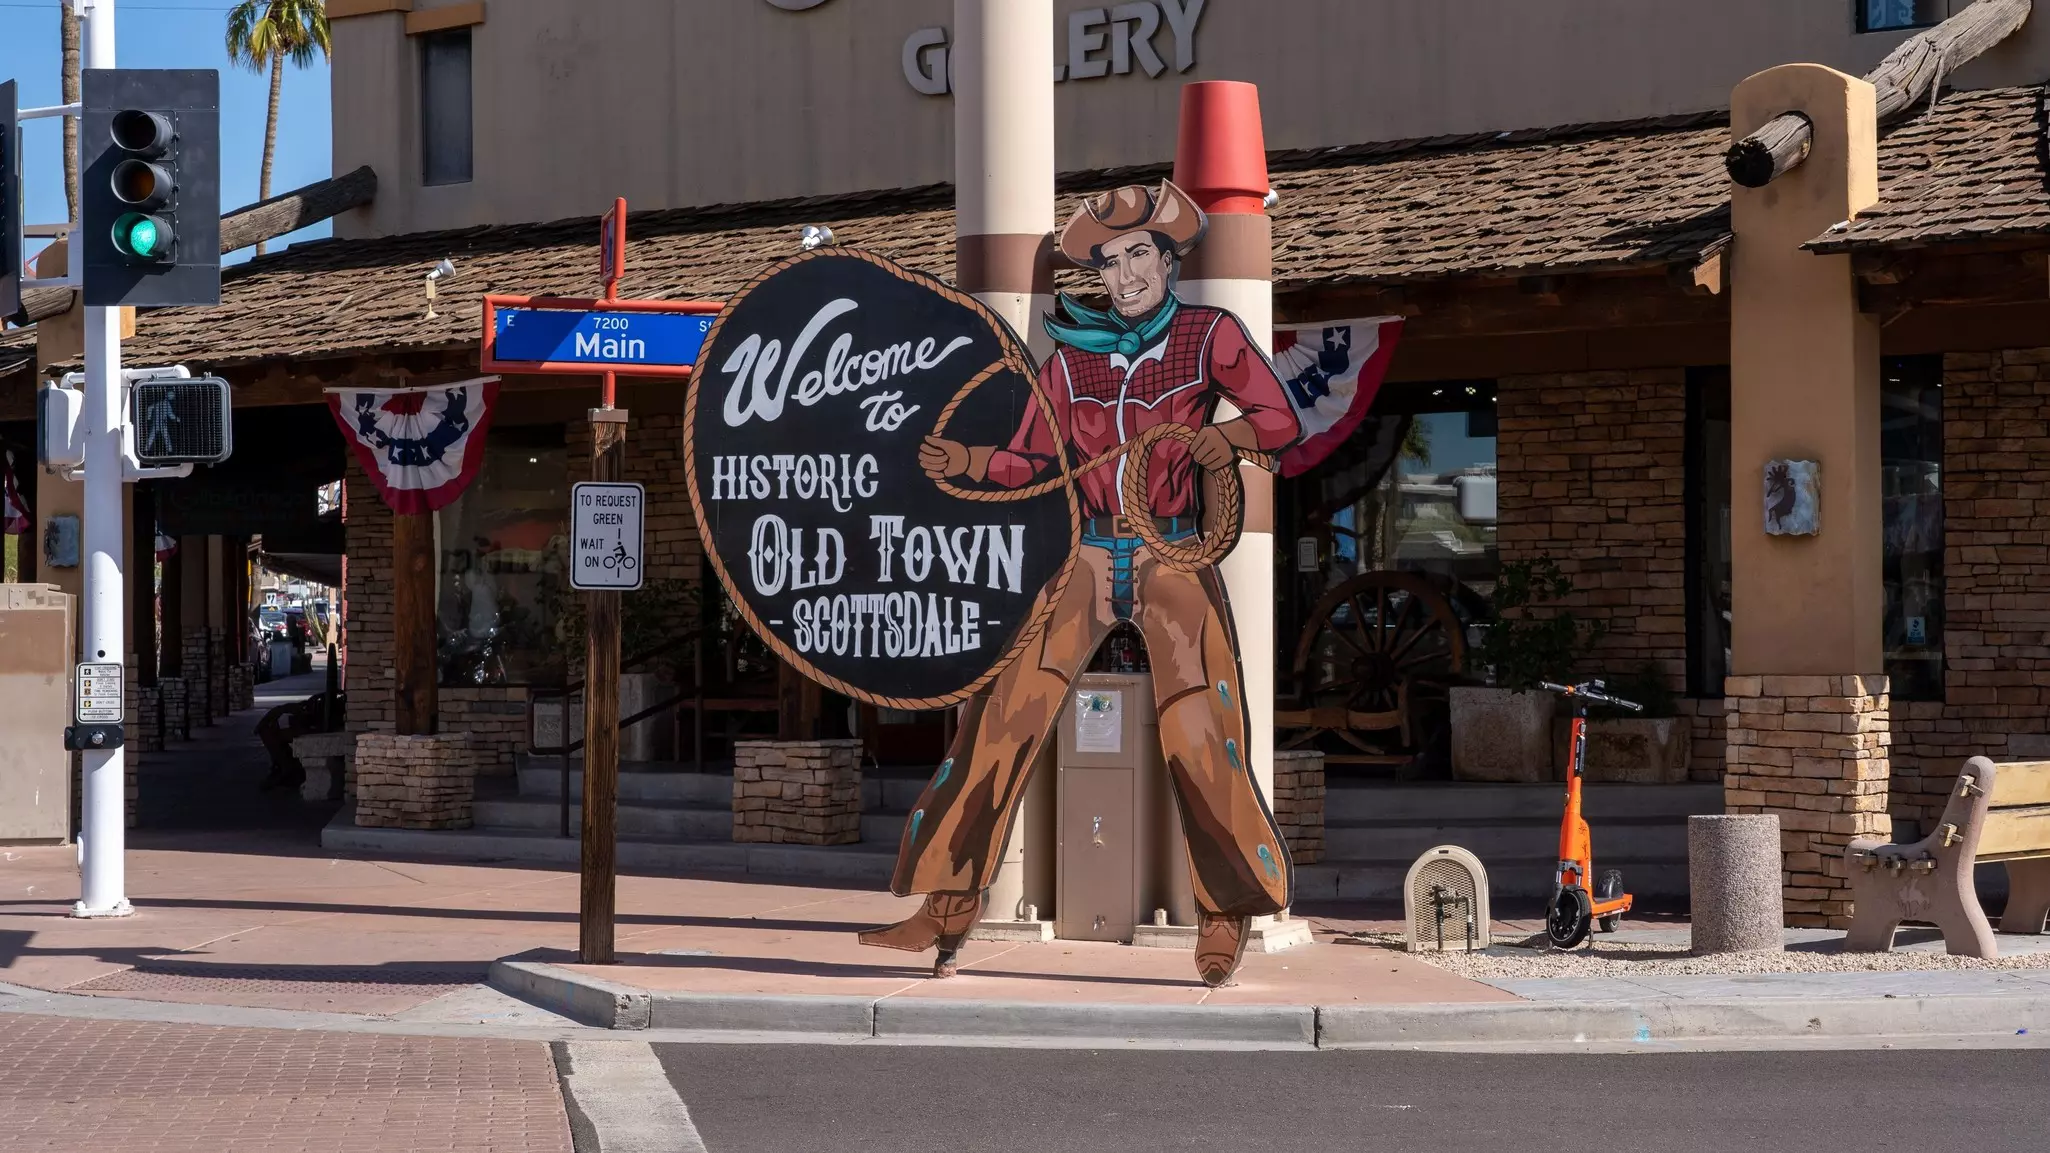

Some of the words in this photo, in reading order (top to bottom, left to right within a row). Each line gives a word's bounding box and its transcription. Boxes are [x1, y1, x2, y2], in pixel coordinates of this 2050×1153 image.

[506, 315, 515, 327] E
[593, 317, 629, 330] 7200
[575, 332, 645, 359] Main
[721, 298, 974, 428] Welcome
[860, 391, 921, 432] to
[711, 453, 879, 513] HISTORIC
[580, 494, 592, 507] TO
[596, 495, 637, 508] REQUEST
[593, 513, 623, 525] GREEN
[580, 538, 605, 550] WAIT
[584, 556, 600, 568] ON
[792, 590, 981, 658] SCOTTSDALE
